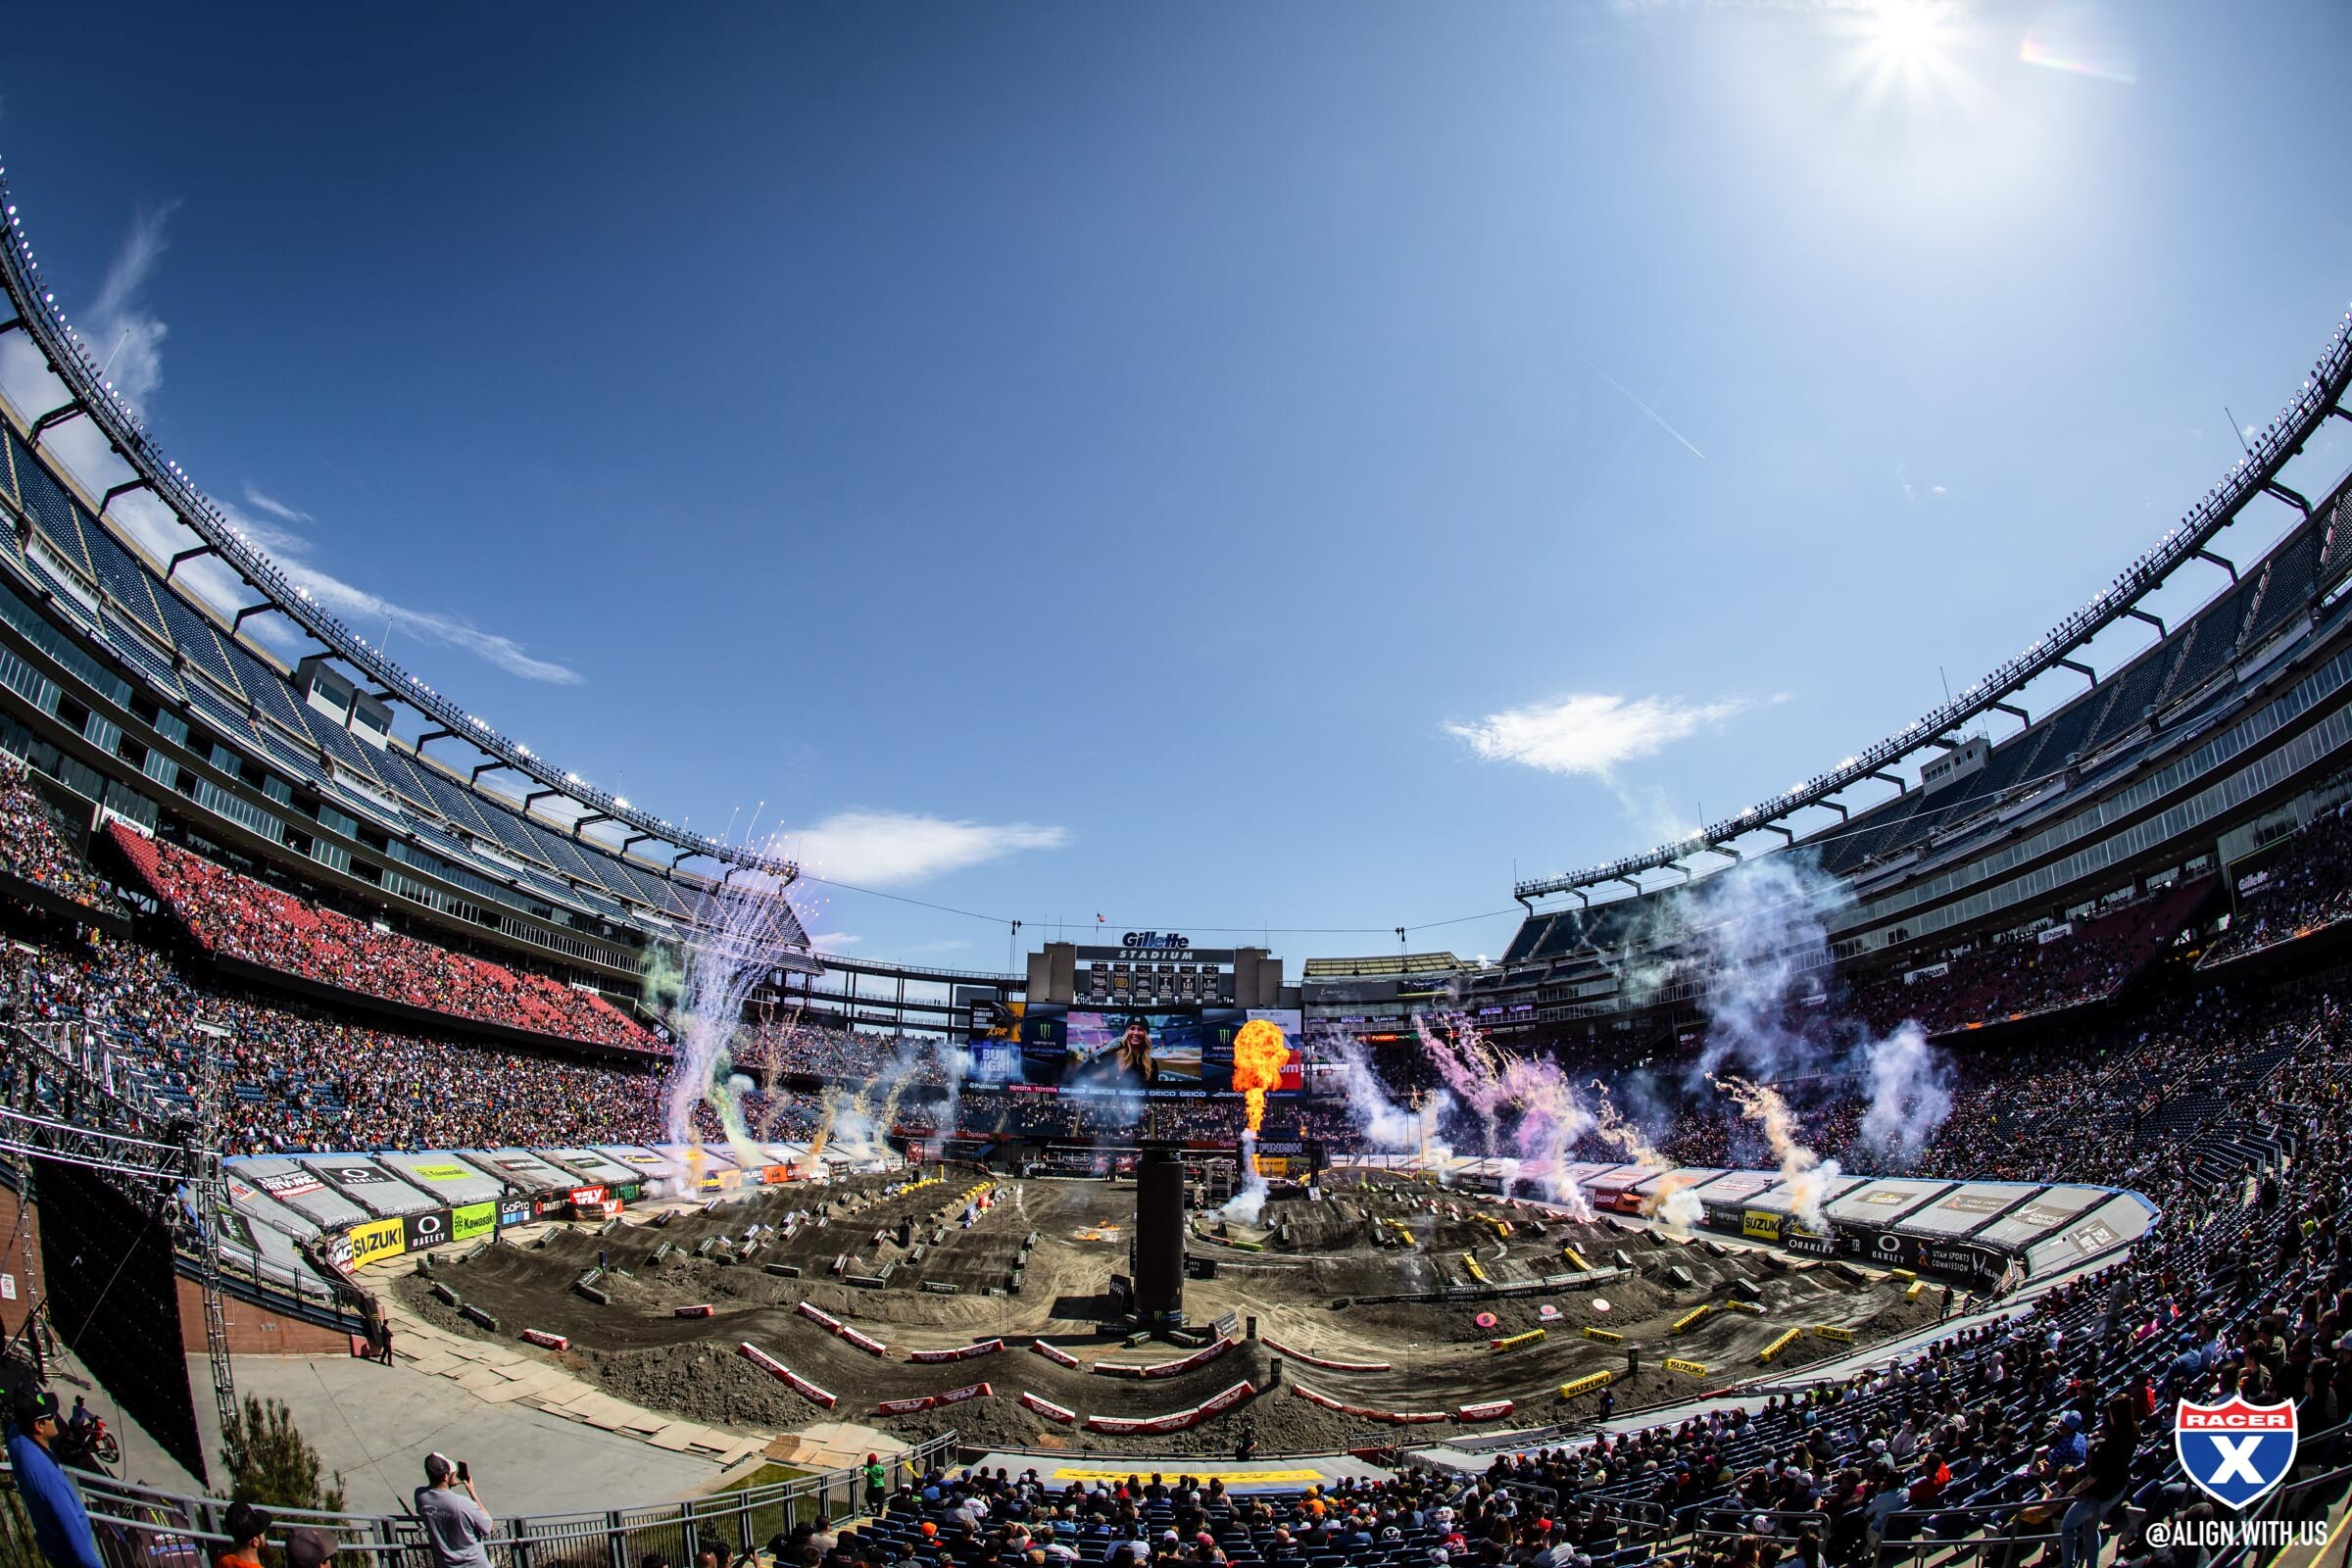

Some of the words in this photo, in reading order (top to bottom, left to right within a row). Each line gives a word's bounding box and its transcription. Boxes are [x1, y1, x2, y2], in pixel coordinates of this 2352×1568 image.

[2238, 870, 2269, 891] Gillette
[2048, 928, 2066, 939] Putnam
[1122, 932, 1190, 950] Gillette
[1118, 950, 1194, 960] STADIUM
[1920, 966, 1946, 978] Putnam
[986, 1028, 1007, 1037] XDR
[1258, 1143, 1302, 1153] FINISH
[502, 1200, 530, 1213] GoPro
[464, 1211, 495, 1231] Kawasaki
[1744, 1217, 1779, 1233] SUZUK
[353, 1227, 403, 1259] SUZUKI
[413, 1232, 445, 1248] OAKLEY
[1797, 1240, 1836, 1254] OAKLEY
[1872, 1251, 1905, 1264] OAKLEY
[1933, 1250, 1947, 1259] UTAH
[1948, 1251, 1970, 1262] SPORTS
[1932, 1259, 1969, 1272] COMMISSION
[1589, 1332, 1623, 1344] SUZUKI
[1821, 1329, 1850, 1339] SUZUKI
[1508, 1333, 1545, 1349] SUZUKI
[1670, 1360, 1705, 1374] SUZUKI
[1568, 1376, 1610, 1396] SUZUKI
[943, 1386, 979, 1400] FLY
[1207, 1388, 1242, 1410] FLY
[887, 1400, 924, 1411] FLY
[1470, 1406, 1506, 1418] FLY
[1097, 1422, 1136, 1433] FLY
[1153, 1414, 1193, 1430] FLY
